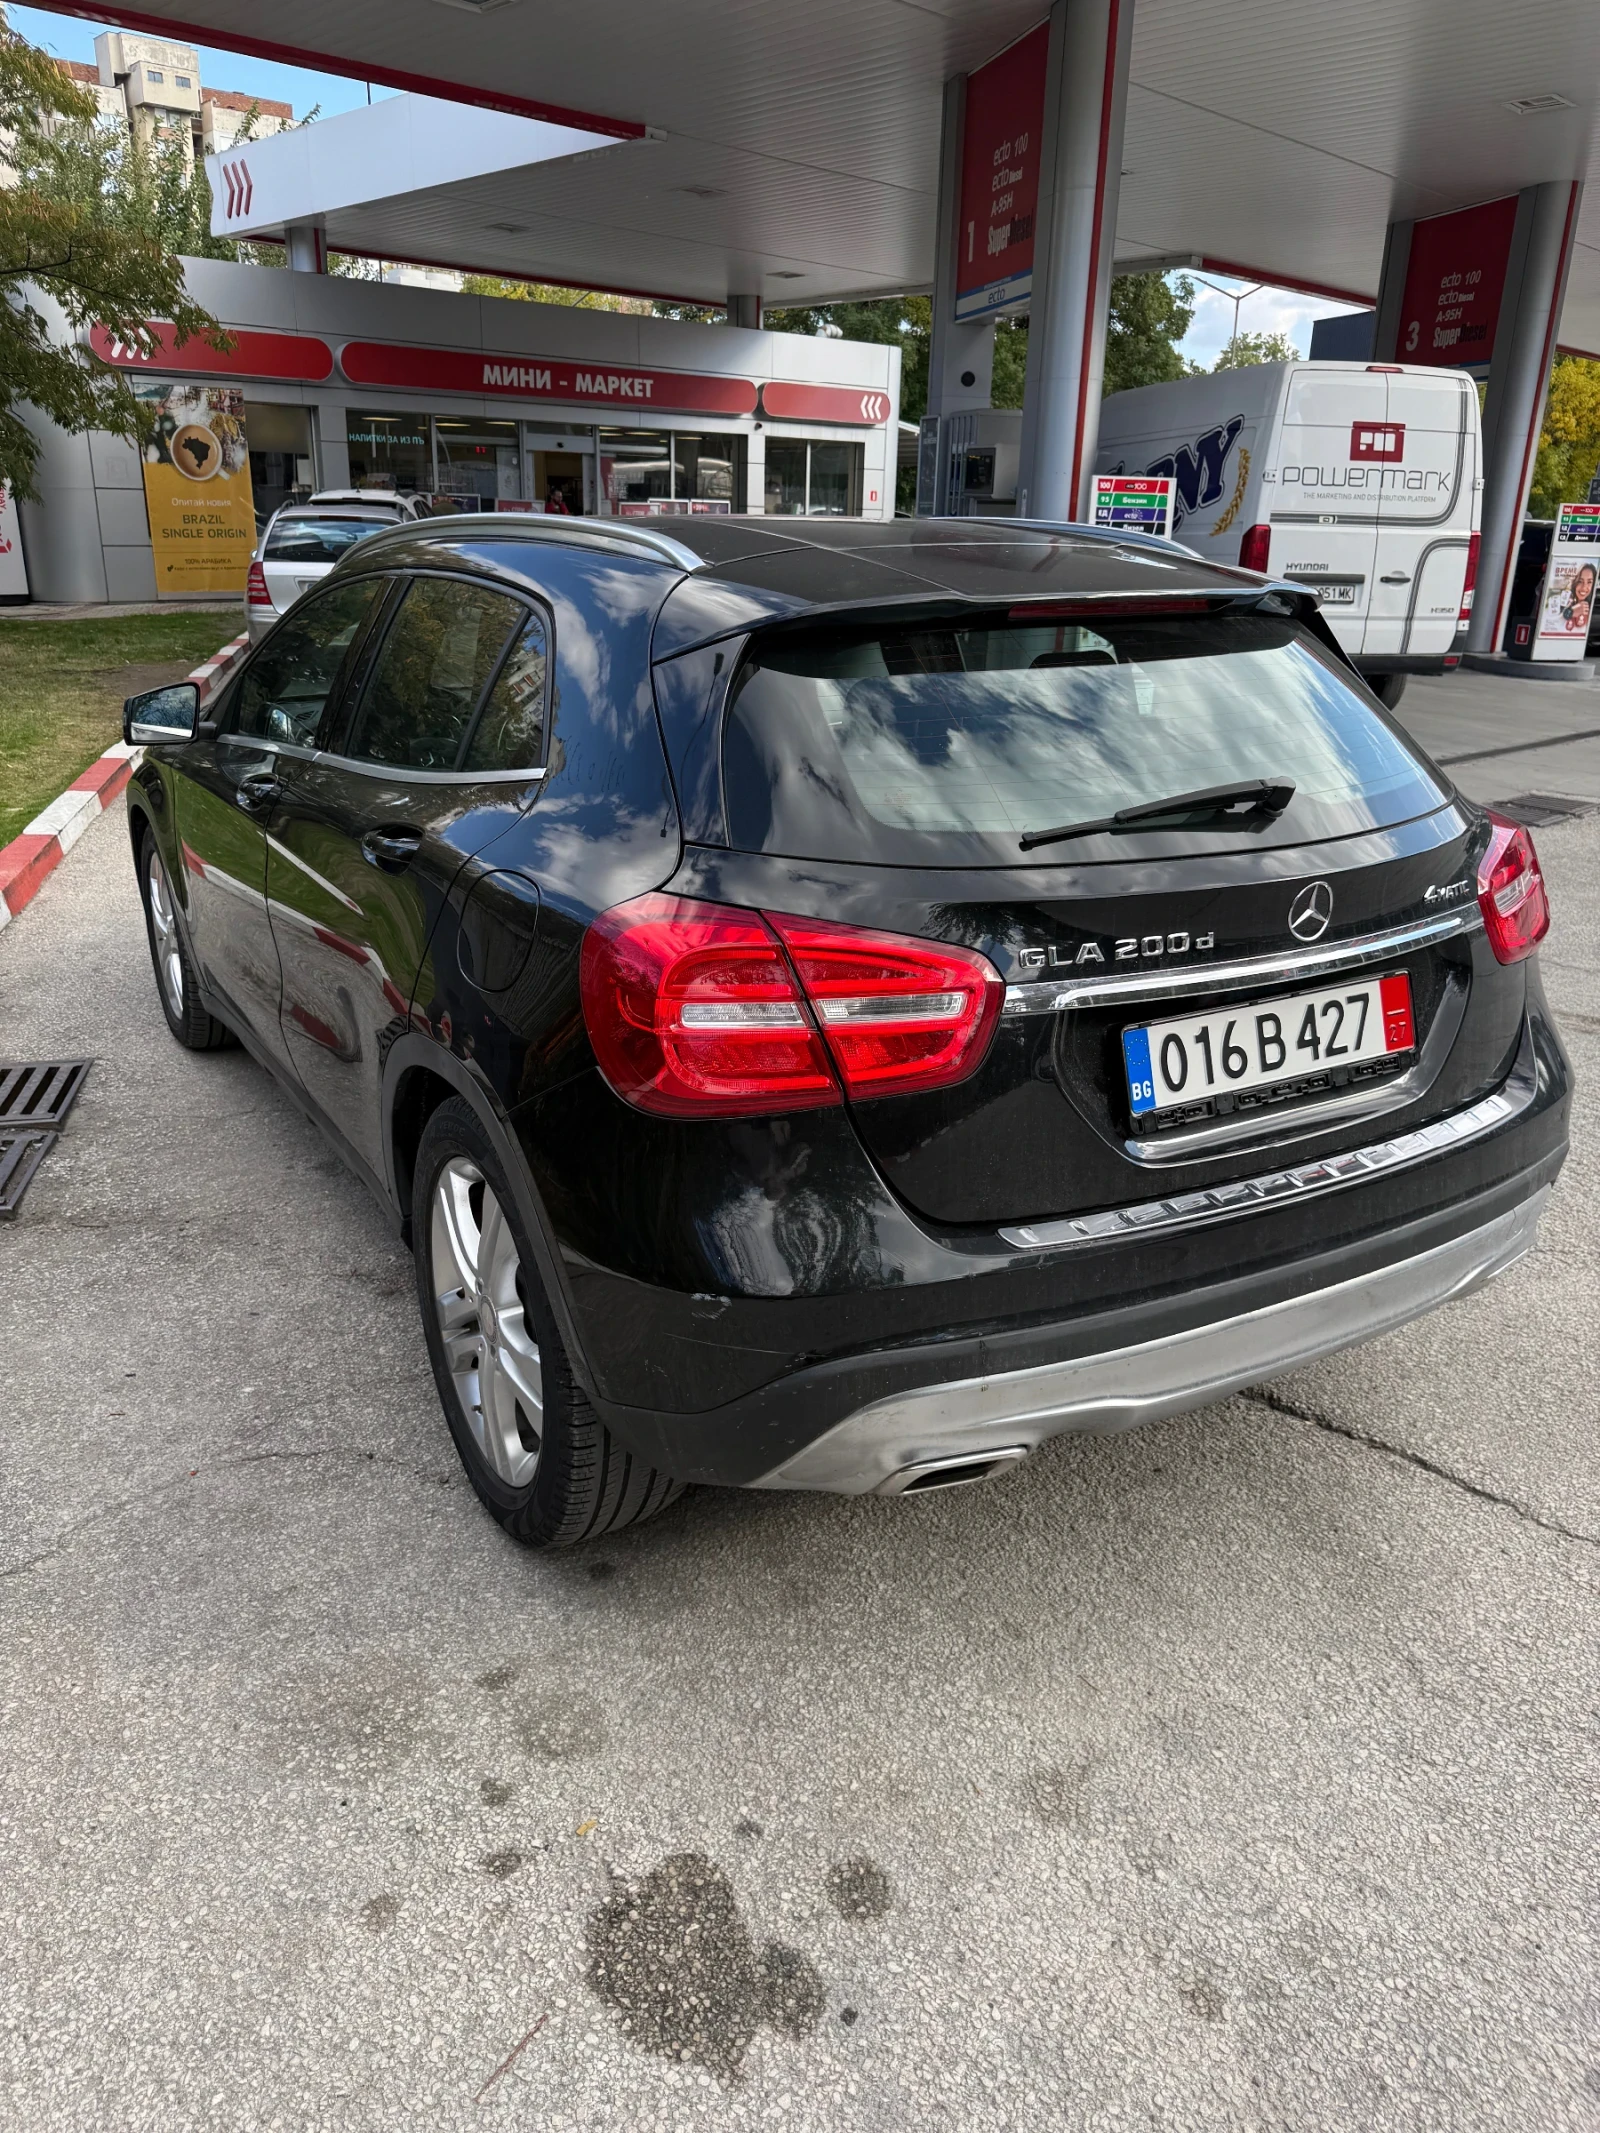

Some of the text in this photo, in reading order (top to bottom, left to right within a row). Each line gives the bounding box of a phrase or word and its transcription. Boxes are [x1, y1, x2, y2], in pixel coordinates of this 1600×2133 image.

[993, 132, 1029, 166] ecto 100
[990, 191, 1014, 218] A-95H
[967, 220, 975, 263] 1
[1440, 269, 1482, 288] ecto 100
[988, 287, 1006, 304] ecto
[1435, 307, 1463, 323] A-95H
[1405, 320, 1420, 352] 3
[483, 364, 552, 390] МИНИ
[575, 373, 653, 398] МАРКЕТ
[349, 433, 386, 443] НАПИТКИ
[387, 435, 398, 444] ЗА
[1099, 481, 1111, 490] 100
[1282, 466, 1451, 492] powermark
[171, 497, 232, 507] Опитай новия
[1122, 496, 1148, 505] Бензин
[1303, 492, 1437, 503] THE MARKETING AND DISTRIBUTION PLATFORM
[182, 514, 225, 525] BRAZIL
[162, 528, 247, 539] SINGLE ORIGIN
[1286, 563, 1329, 572] HYUNDAI
[1019, 942, 1105, 970] GLA
[1389, 1021, 1408, 1043] 27
[1132, 1081, 1152, 1101] BG
